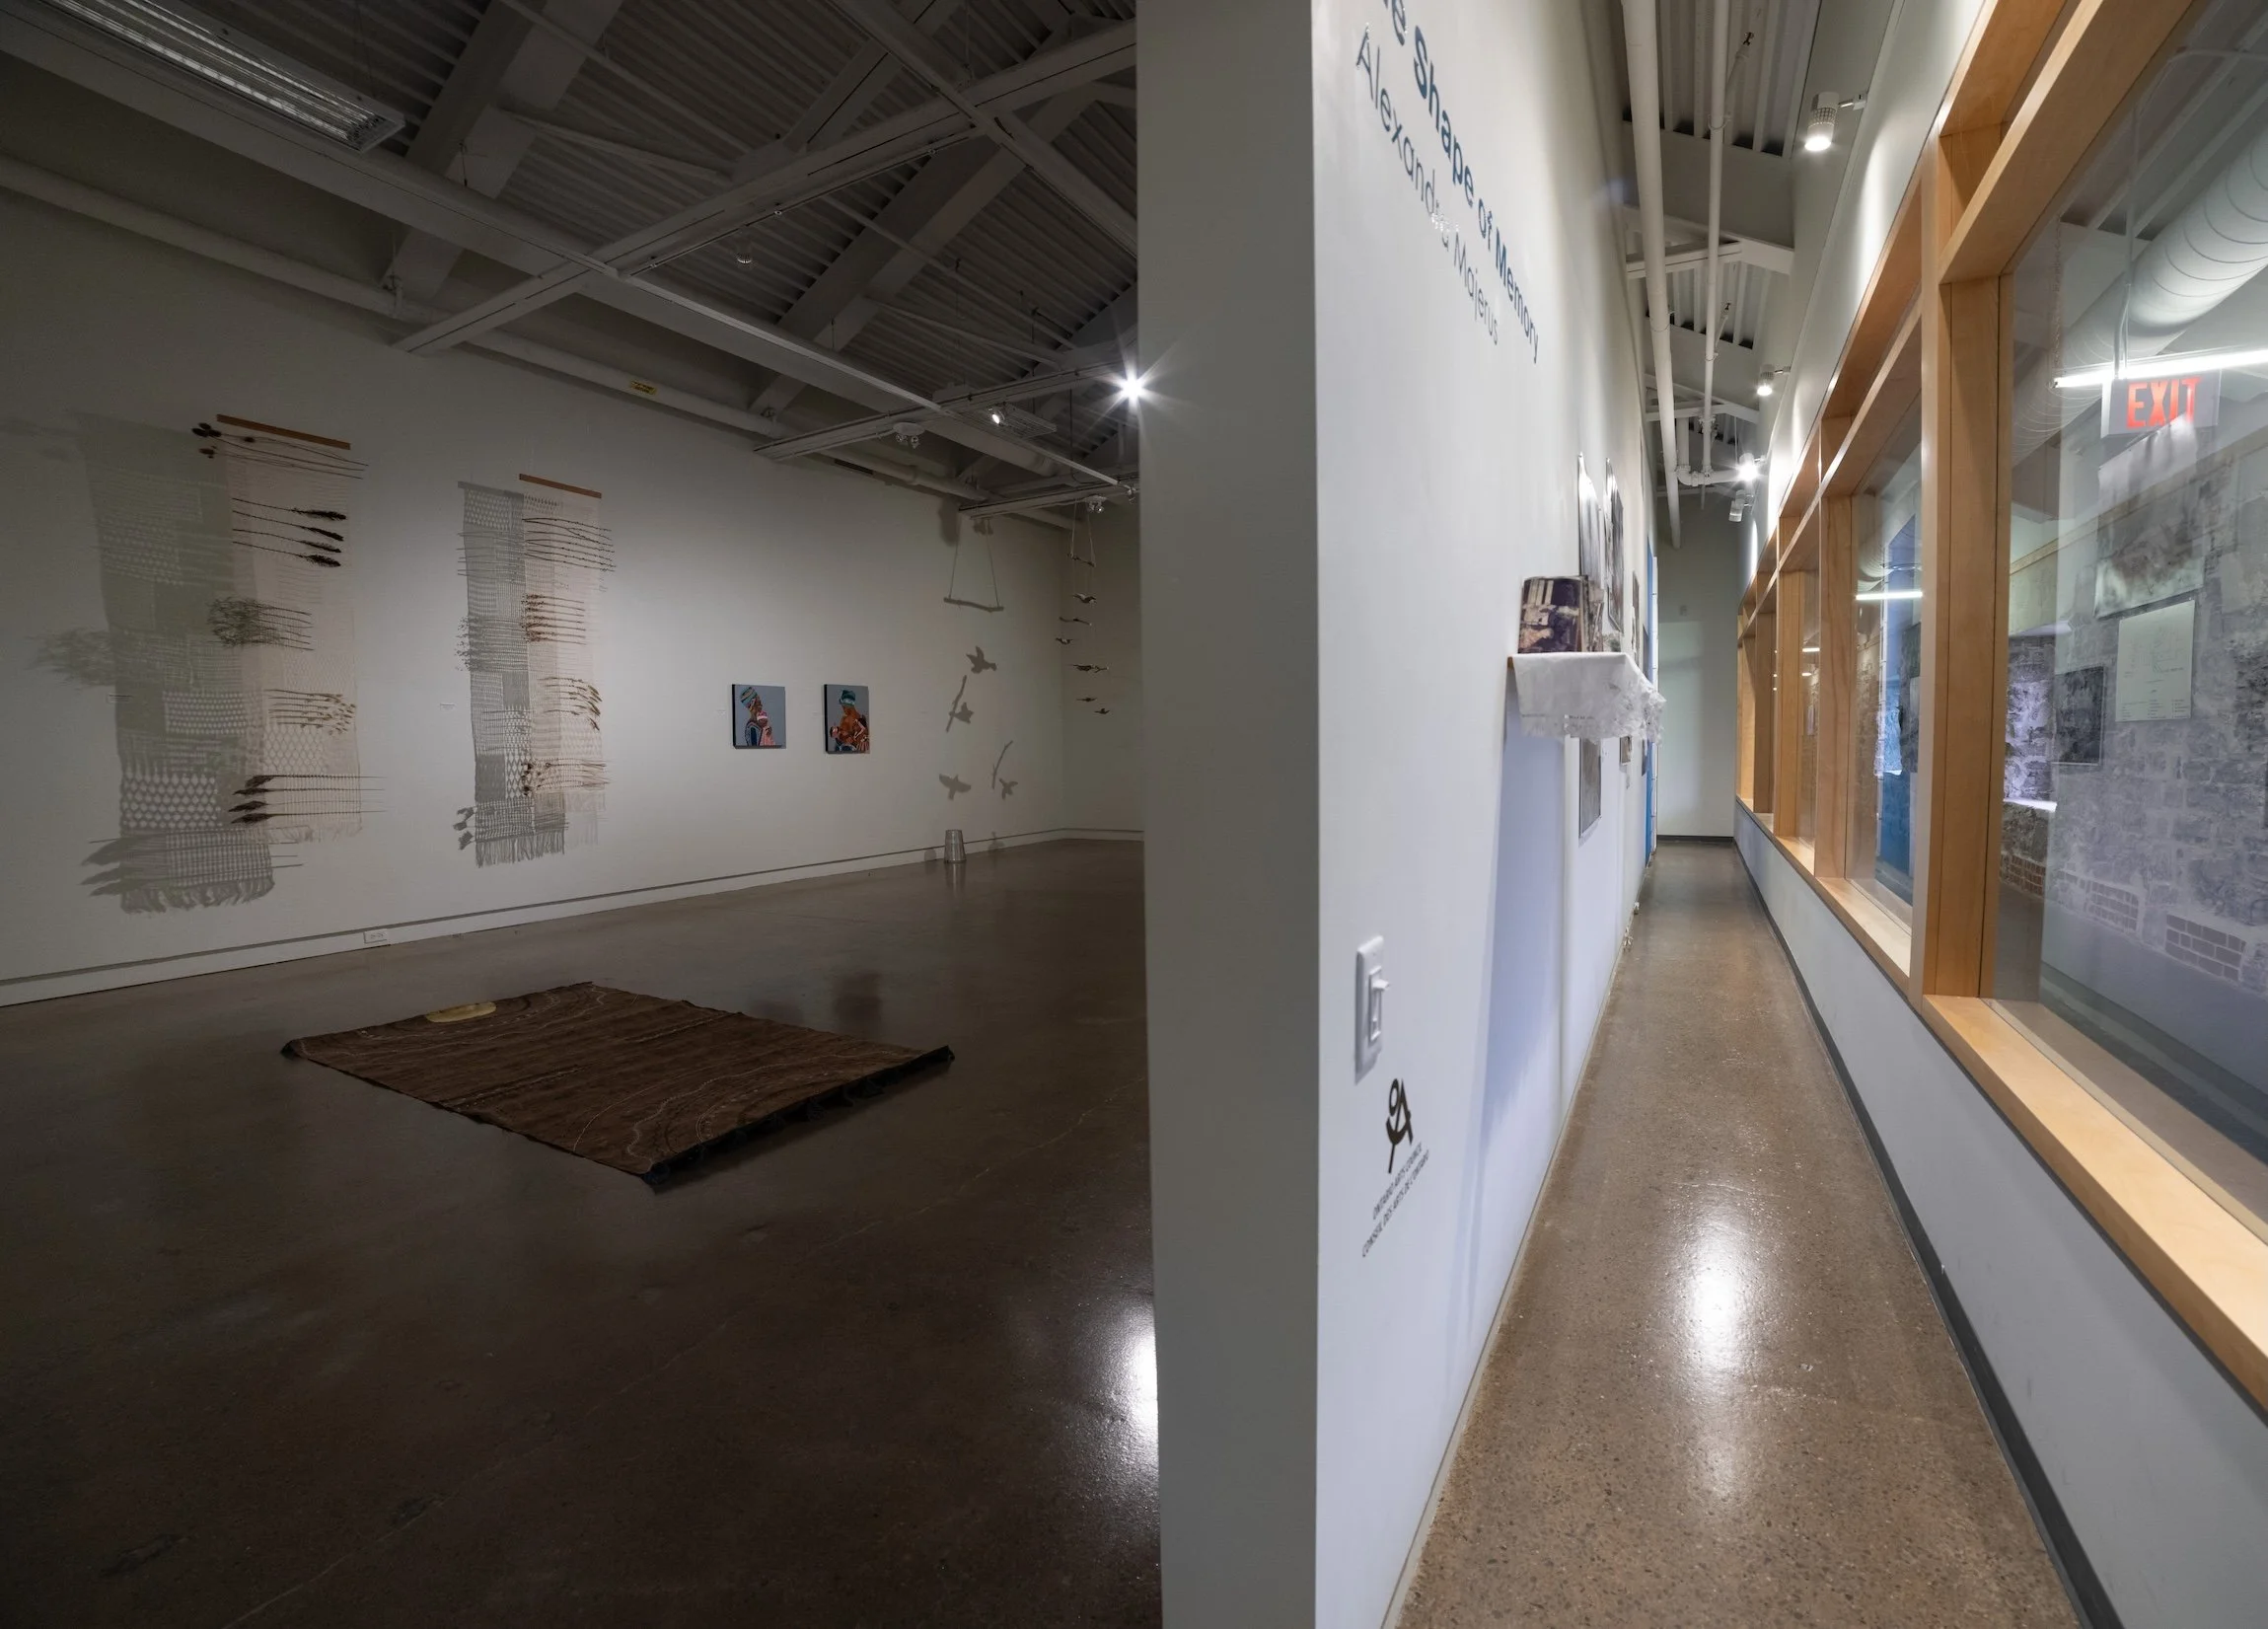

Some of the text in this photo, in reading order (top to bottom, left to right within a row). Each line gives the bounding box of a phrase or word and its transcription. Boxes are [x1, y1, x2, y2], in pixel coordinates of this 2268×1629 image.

[1413, 25, 1475, 209] Shape
[1478, 197, 1494, 252] of
[1496, 226, 1539, 364] Memory
[1453, 232, 1499, 346] Majerus
[2126, 377, 2201, 428] EXIT
